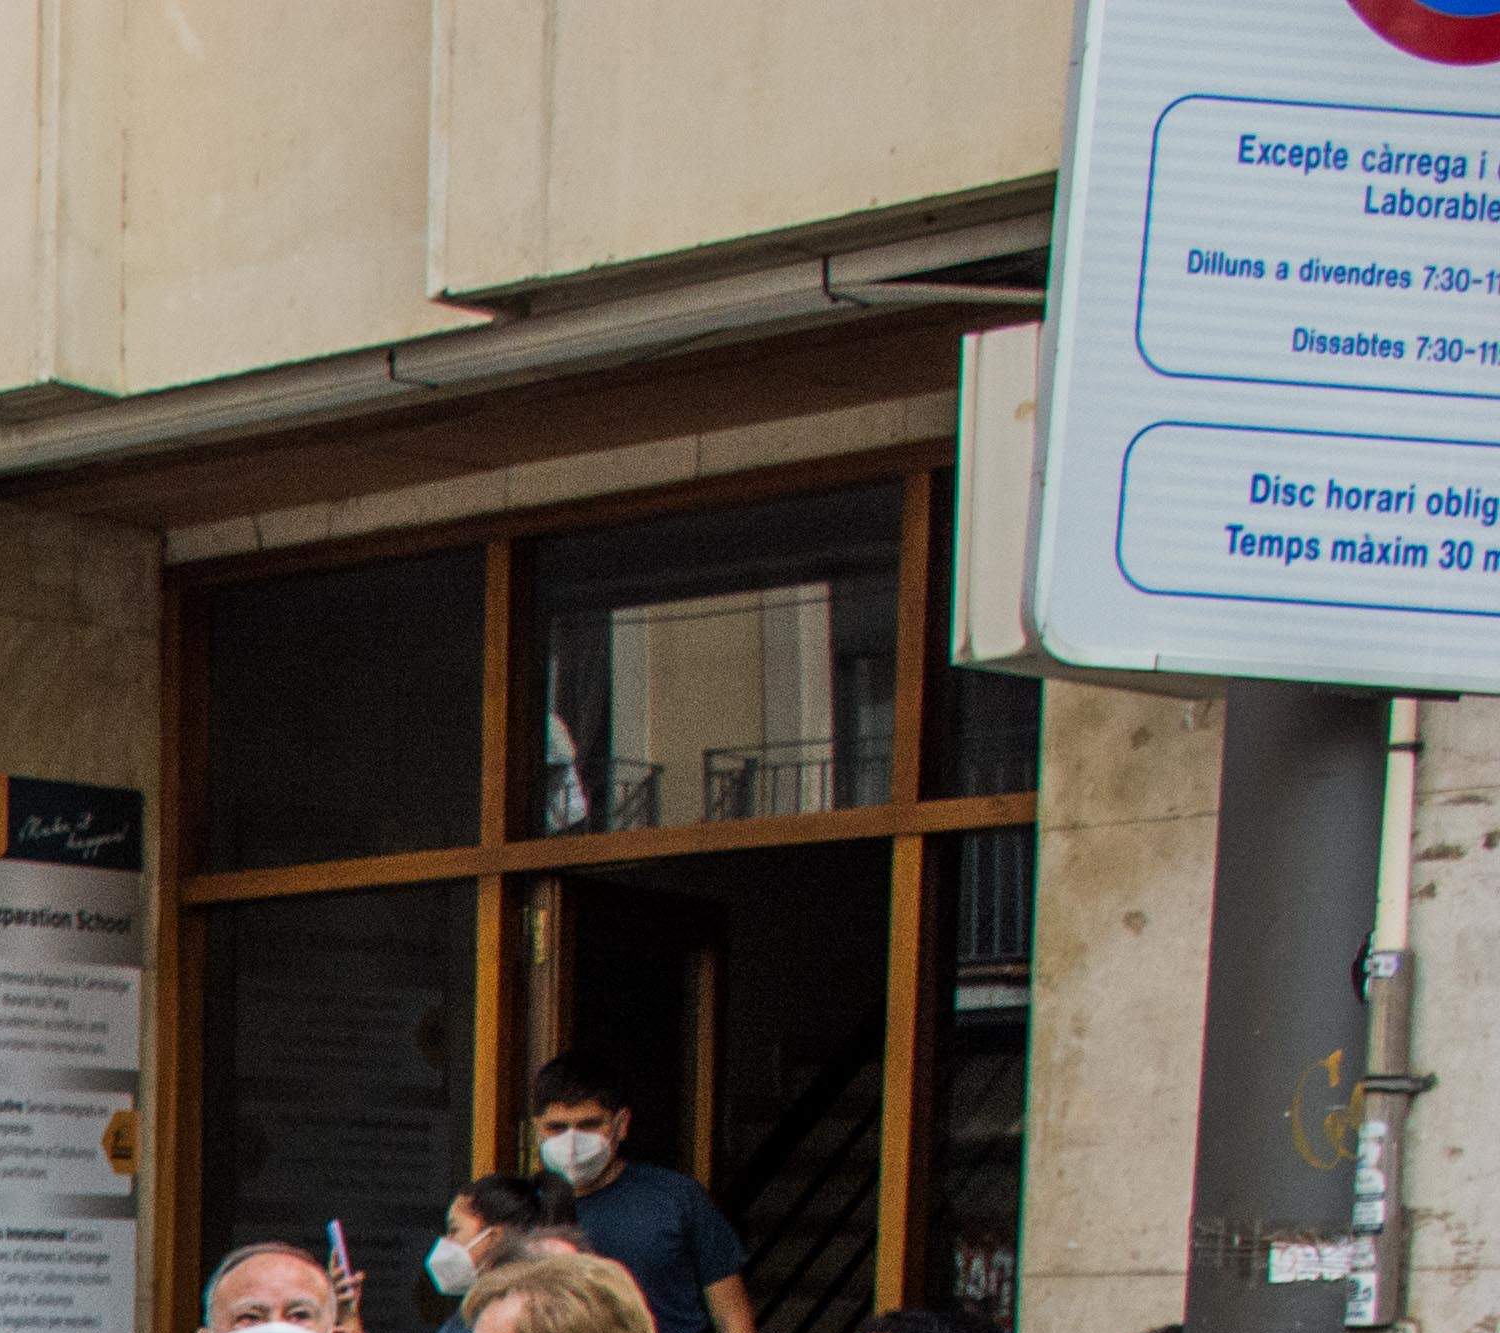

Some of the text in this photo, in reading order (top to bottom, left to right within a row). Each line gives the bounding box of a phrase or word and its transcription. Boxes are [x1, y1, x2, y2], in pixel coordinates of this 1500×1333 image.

[1237, 133, 1487, 184] Excepte càrrega i
[1186, 248, 1266, 279] Dilluns
[1275, 261, 1289, 281] a
[1299, 257, 1412, 289] divendres
[1291, 325, 1405, 359] Dissabtes
[1249, 472, 1500, 527] Disc horari oblig
[1225, 523, 1321, 566] Temps
[1330, 533, 1429, 568] màxim
[1438, 539, 1474, 571] 30
[76, 908, 133, 935] School
[6, 1226, 67, 1242] International
